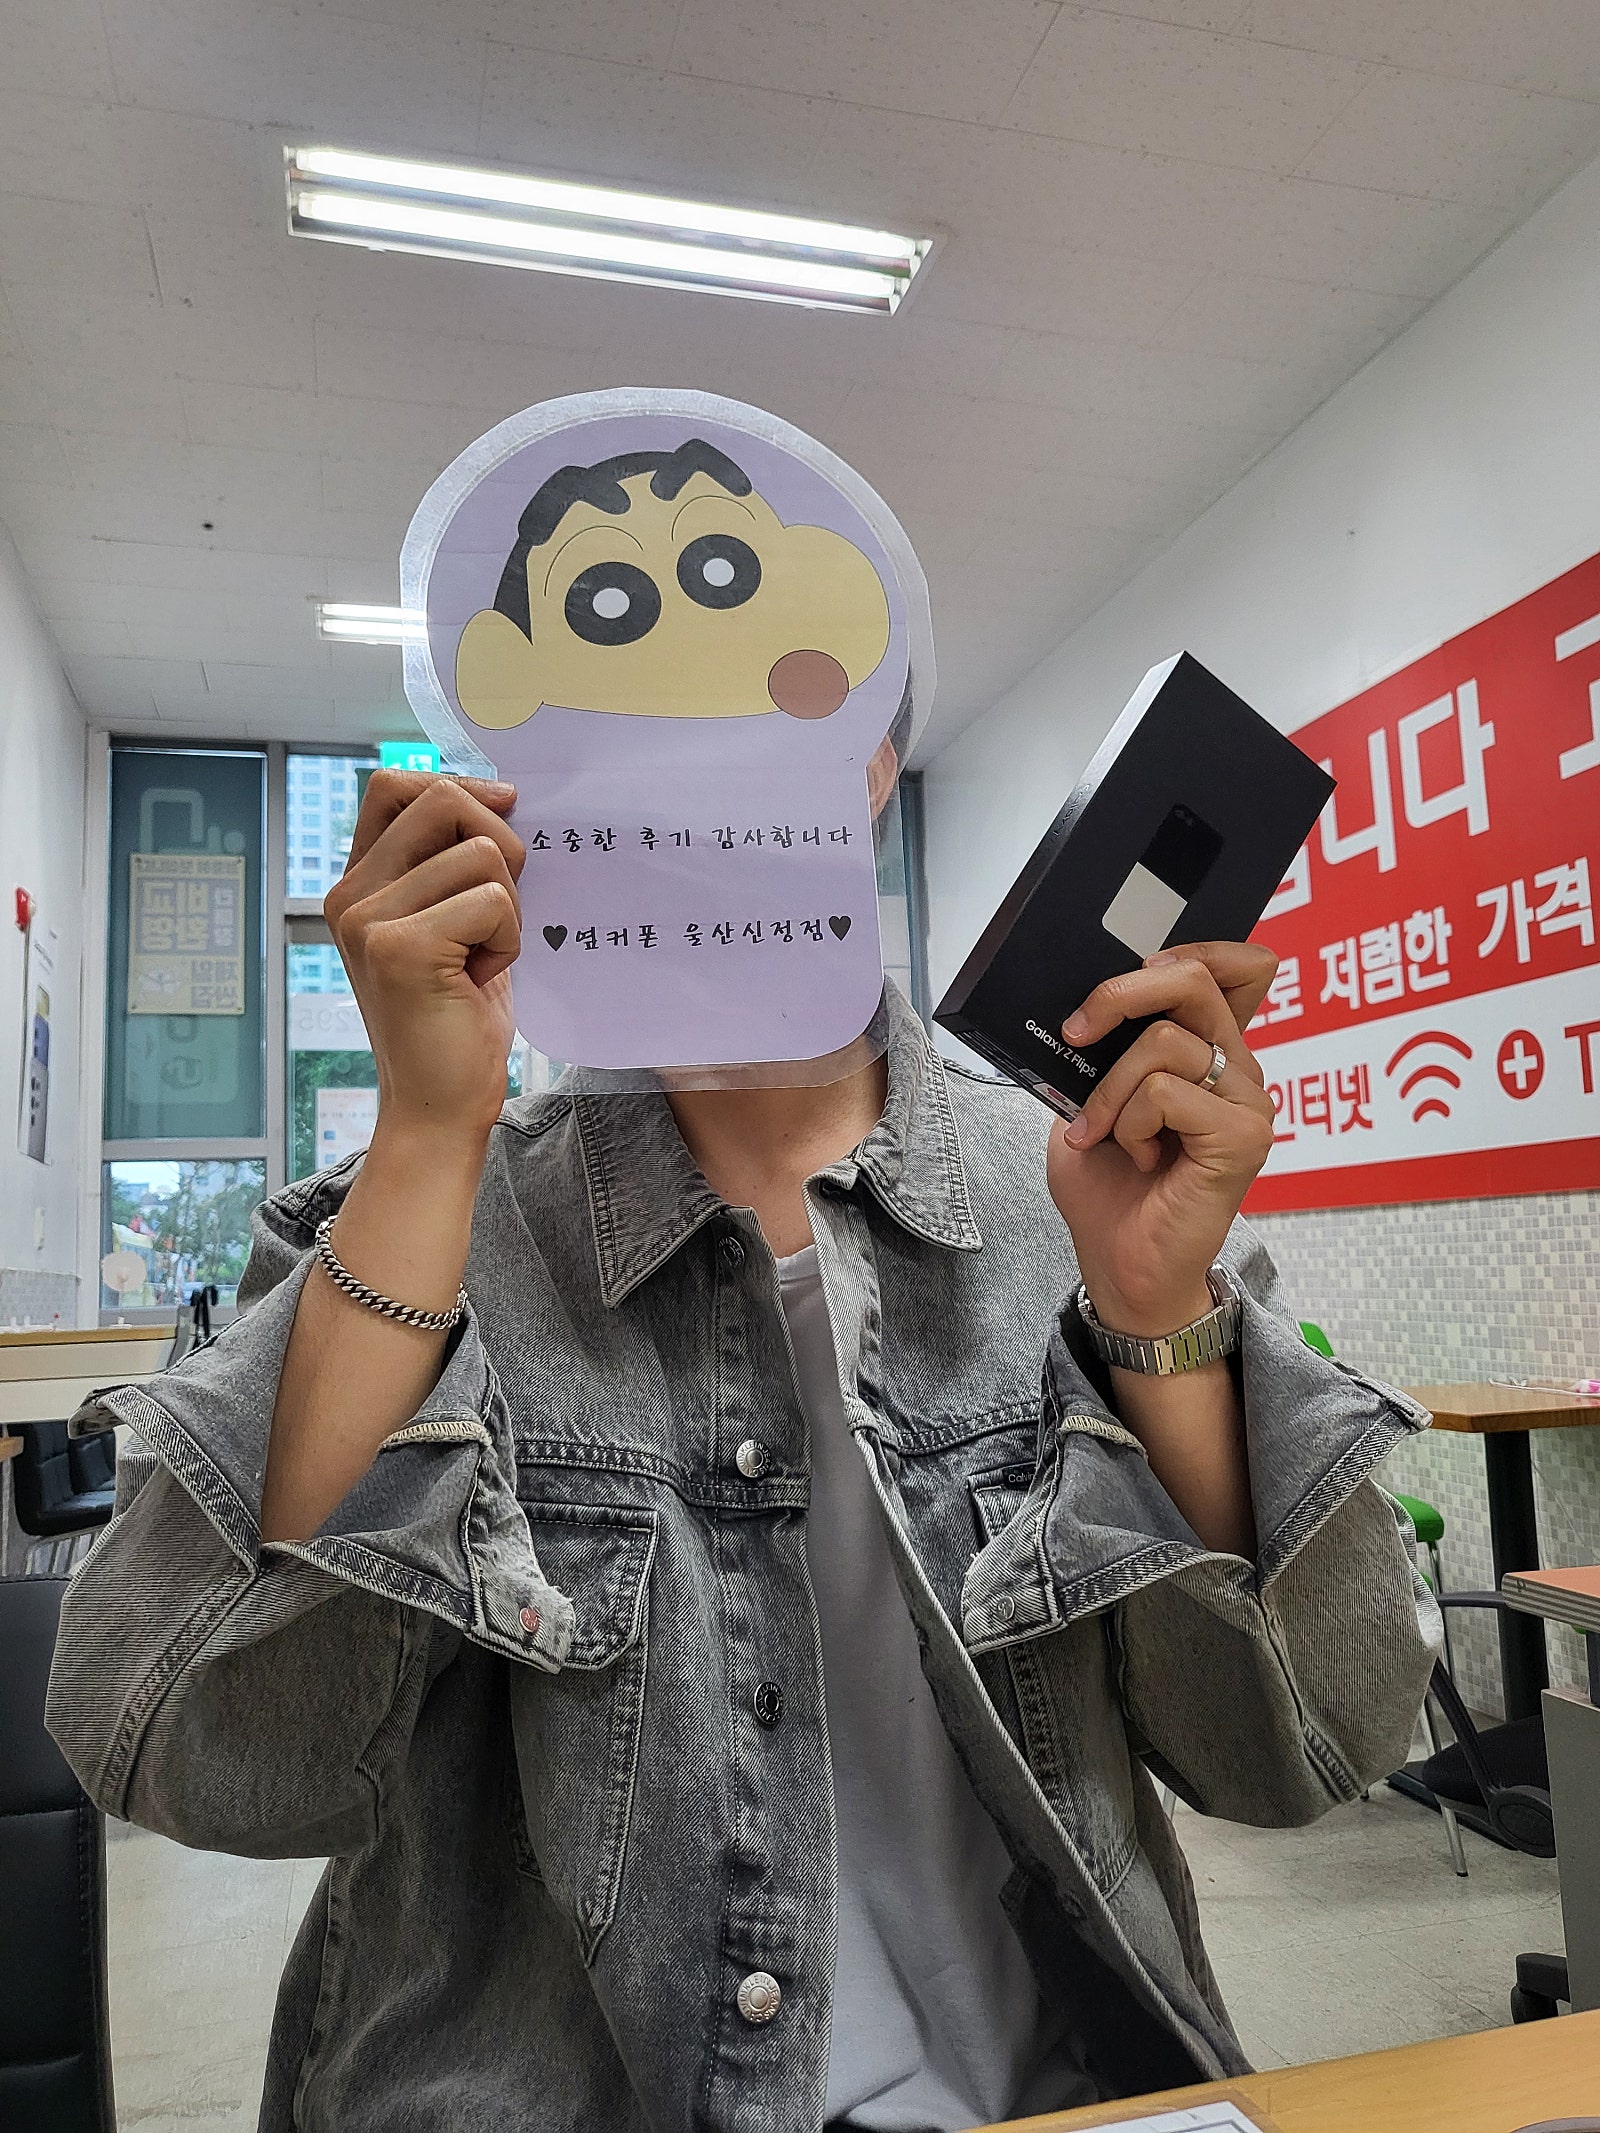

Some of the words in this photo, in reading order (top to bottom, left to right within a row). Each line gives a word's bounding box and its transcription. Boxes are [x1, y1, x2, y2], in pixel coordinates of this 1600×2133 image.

[531, 827, 618, 853] 소중한
[639, 826, 692, 852] 후기
[712, 825, 854, 851] 감사합니다
[575, 923, 661, 951] 옆커폰
[683, 918, 824, 947] 울산신정점
[1318, 905, 1454, 1011] 저렴한
[1475, 856, 1597, 966] 가격
[1025, 1019, 1064, 1055] Galaxy
[1063, 1047, 1074, 1060] Z
[1071, 1053, 1098, 1078] Flip5
[1264, 1062, 1375, 1144] 인터넷
